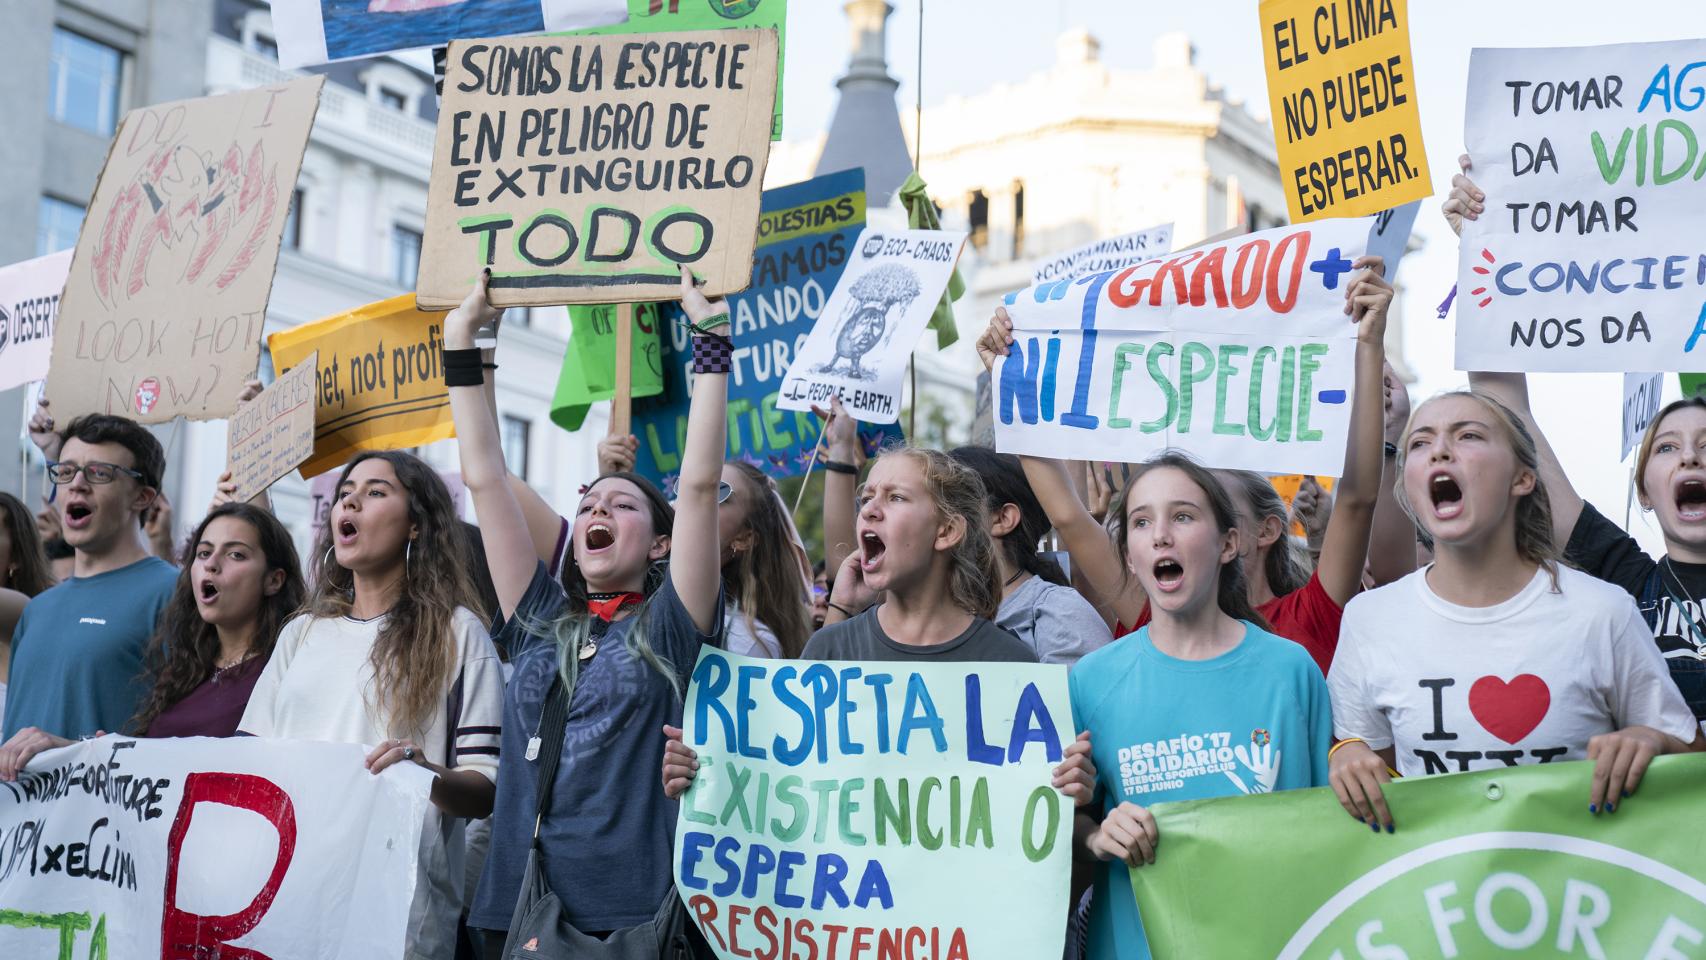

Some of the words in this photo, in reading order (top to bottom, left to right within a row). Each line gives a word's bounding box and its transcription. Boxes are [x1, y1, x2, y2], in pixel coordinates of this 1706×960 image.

[1273, 17, 1308, 70] EL
[1313, 0, 1398, 55] CLIMA
[457, 45, 563, 97] SOMOS
[568, 45, 603, 93] LA
[613, 41, 750, 91] ESPECIE
[1283, 87, 1318, 143] NO
[1323, 55, 1408, 130] PUEDE
[1505, 75, 1623, 117] TOMAR
[127, 105, 187, 158] DO
[451, 110, 506, 166] EN
[518, 101, 654, 157] PELIGRO
[665, 103, 710, 149] DE
[1511, 137, 1559, 177] DA
[1590, 119, 1706, 187] VID
[454, 155, 754, 207] EXTINGUIRLO
[1294, 134, 1419, 217] ESPERAR.
[457, 205, 714, 268] TODO
[757, 198, 856, 237] OLESTIAS
[1505, 196, 1639, 235] TOMAR
[883, 238, 908, 257] ECO
[1108, 230, 1312, 315] GRADO
[76, 316, 166, 363] LOOK
[188, 311, 263, 359] HOT
[1510, 317, 1585, 348] NOS
[1600, 311, 1652, 344] DA
[350, 337, 386, 397] not
[1107, 341, 1330, 443] ESPECIE
[853, 390, 893, 415] EARTH.
[692, 653, 948, 767] RESPETA
[965, 673, 1063, 767] LA
[1418, 677, 1457, 742] I
[1120, 747, 1235, 779] SOLIDARIO
[1122, 773, 1165, 788] REEBOK
[1165, 767, 1207, 781] SPORTS
[1206, 761, 1237, 774] CLUB
[1124, 786, 1135, 797] 17
[1135, 784, 1151, 795] DE
[1150, 779, 1185, 793] JUNIO
[683, 755, 995, 849] EXISTENCIA
[1021, 785, 1061, 863] O
[680, 831, 895, 911] ESPERA
[689, 895, 970, 960] RESISTENCIA
[1423, 872, 1613, 959] FOR
